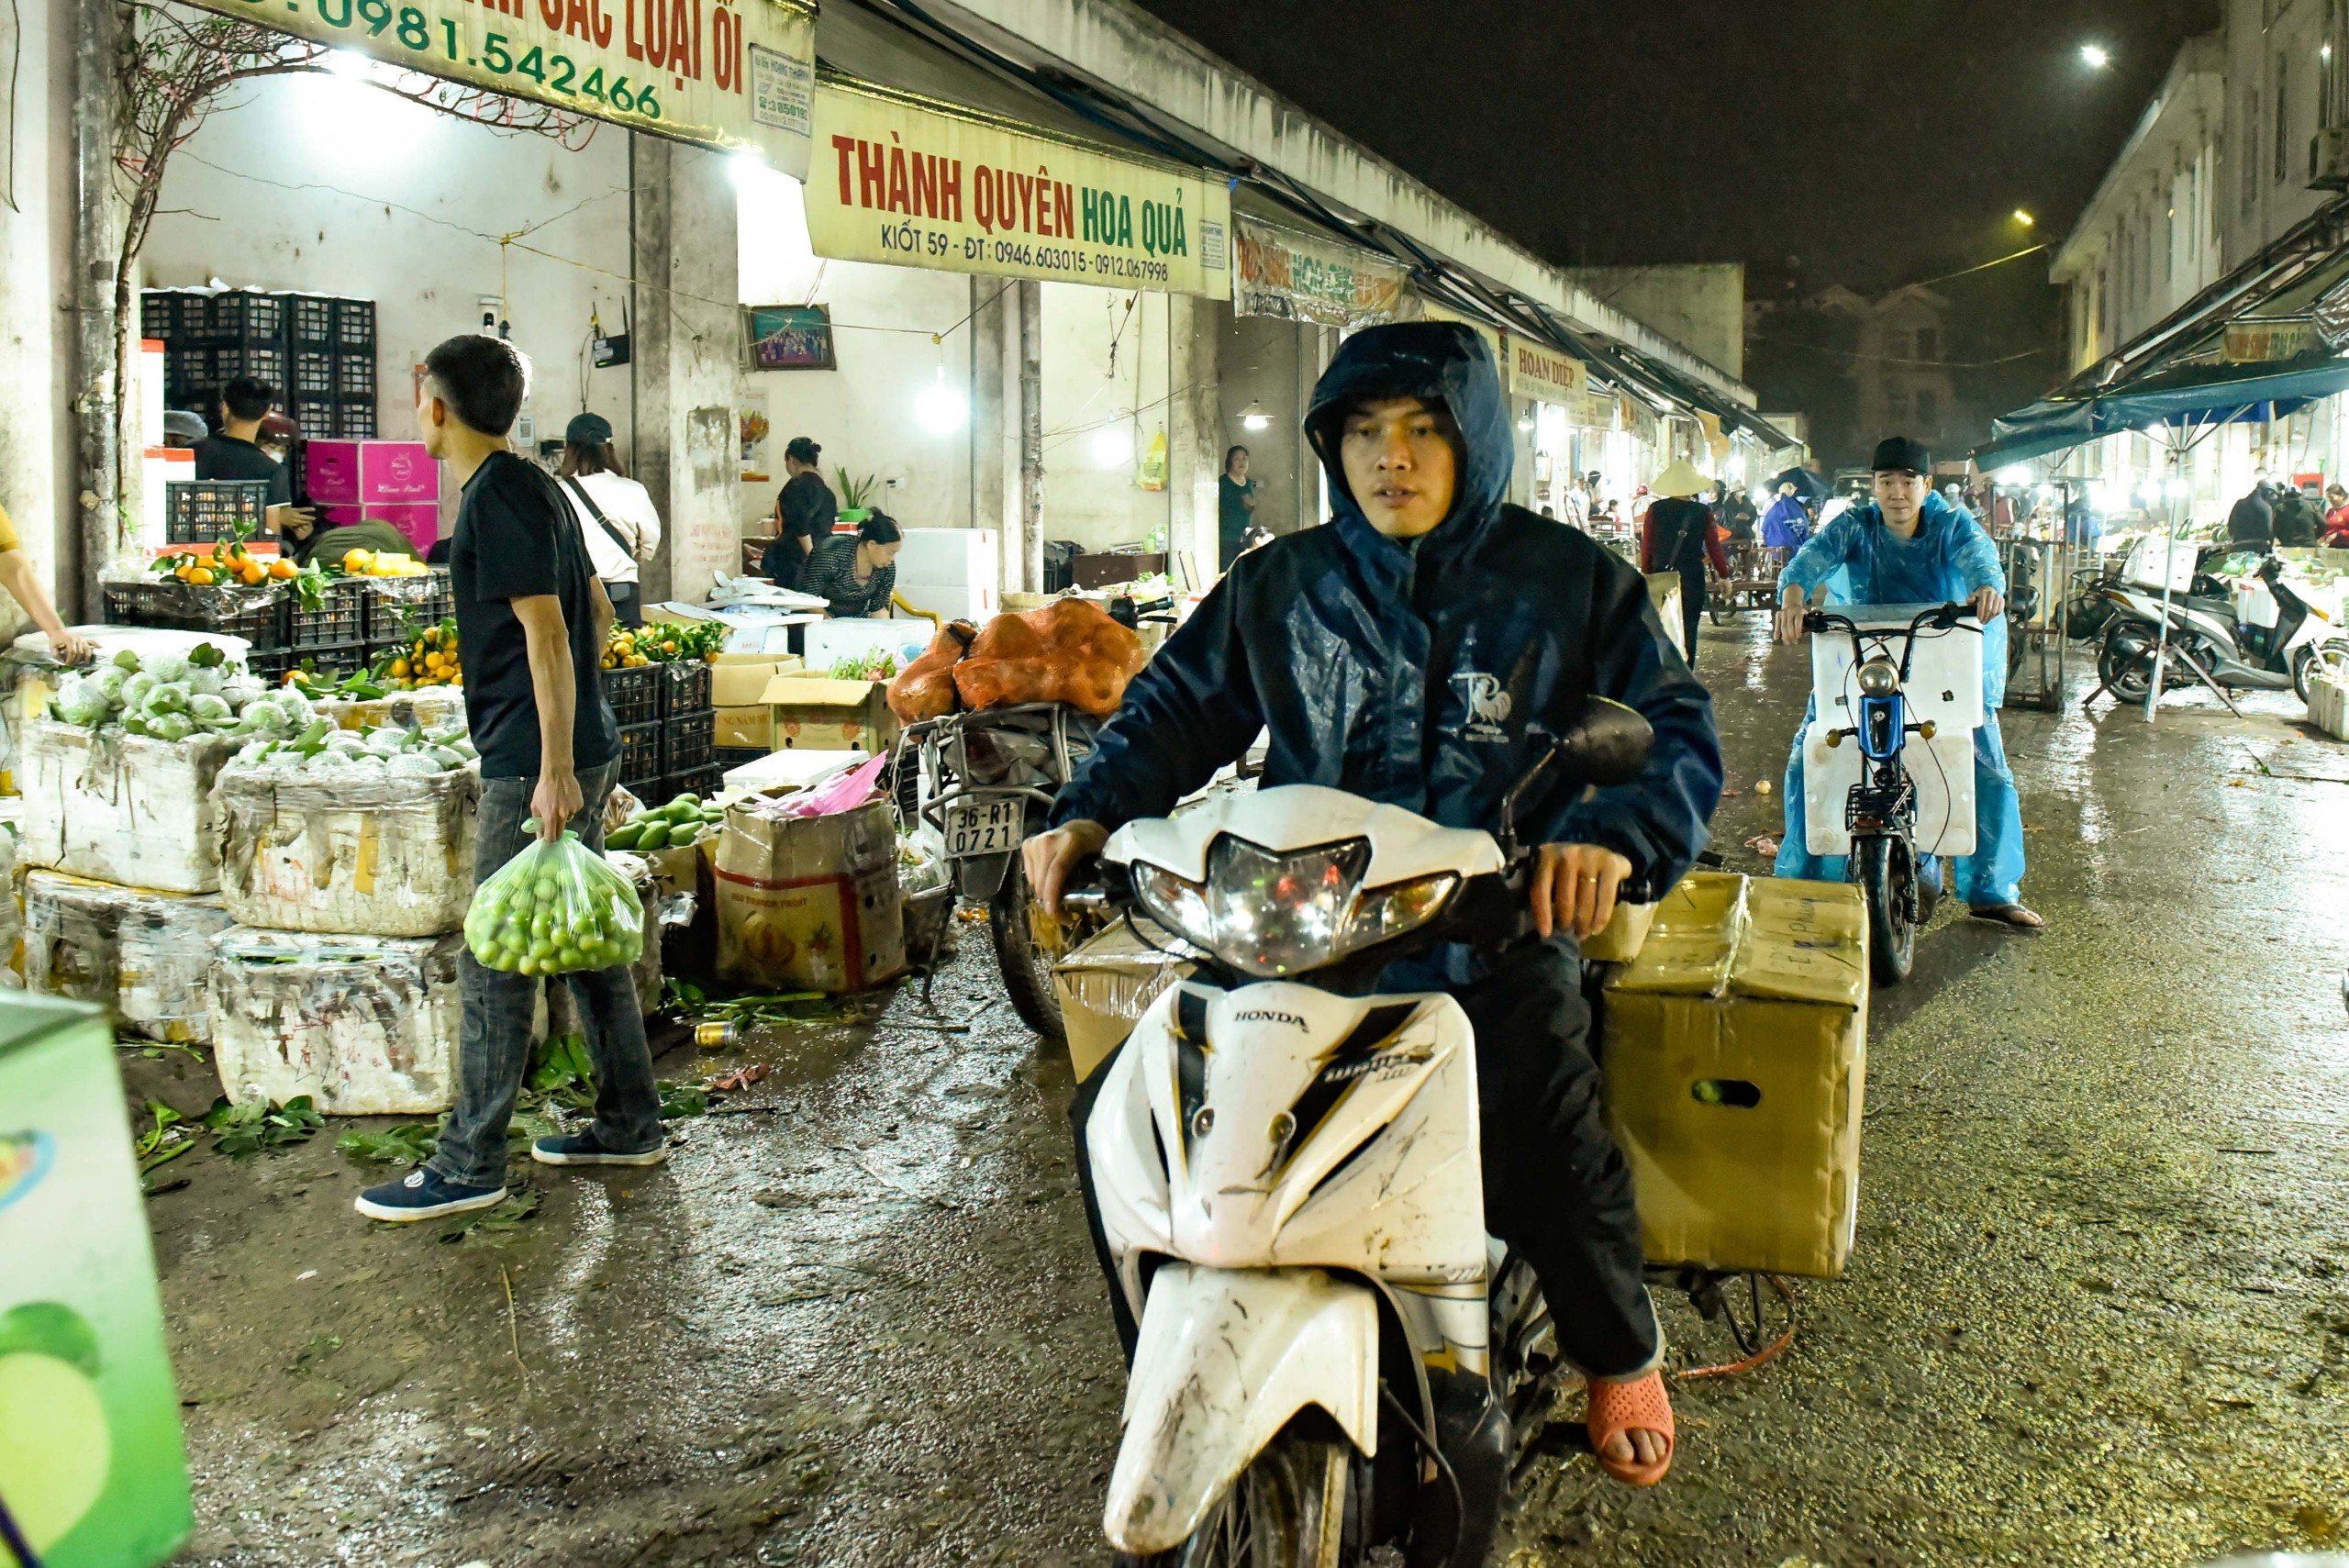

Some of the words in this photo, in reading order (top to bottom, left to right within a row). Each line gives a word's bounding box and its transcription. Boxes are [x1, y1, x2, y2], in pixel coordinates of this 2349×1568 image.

[317, 0, 661, 119] 0981.542466
[625, 0, 702, 92] LOẠI
[831, 130, 963, 223] THÀNH
[974, 165, 1074, 239] QUYÊN
[1081, 186, 1134, 249] HOA
[1141, 186, 1188, 258] QUẢ
[881, 218, 921, 253] KIỐT
[928, 231, 949, 257] 59
[1518, 348, 1551, 382] HOAN
[957, 802, 1012, 828] 36-R1
[955, 826, 1010, 853] 0721
[1233, 1010, 1307, 1028] HONDA
